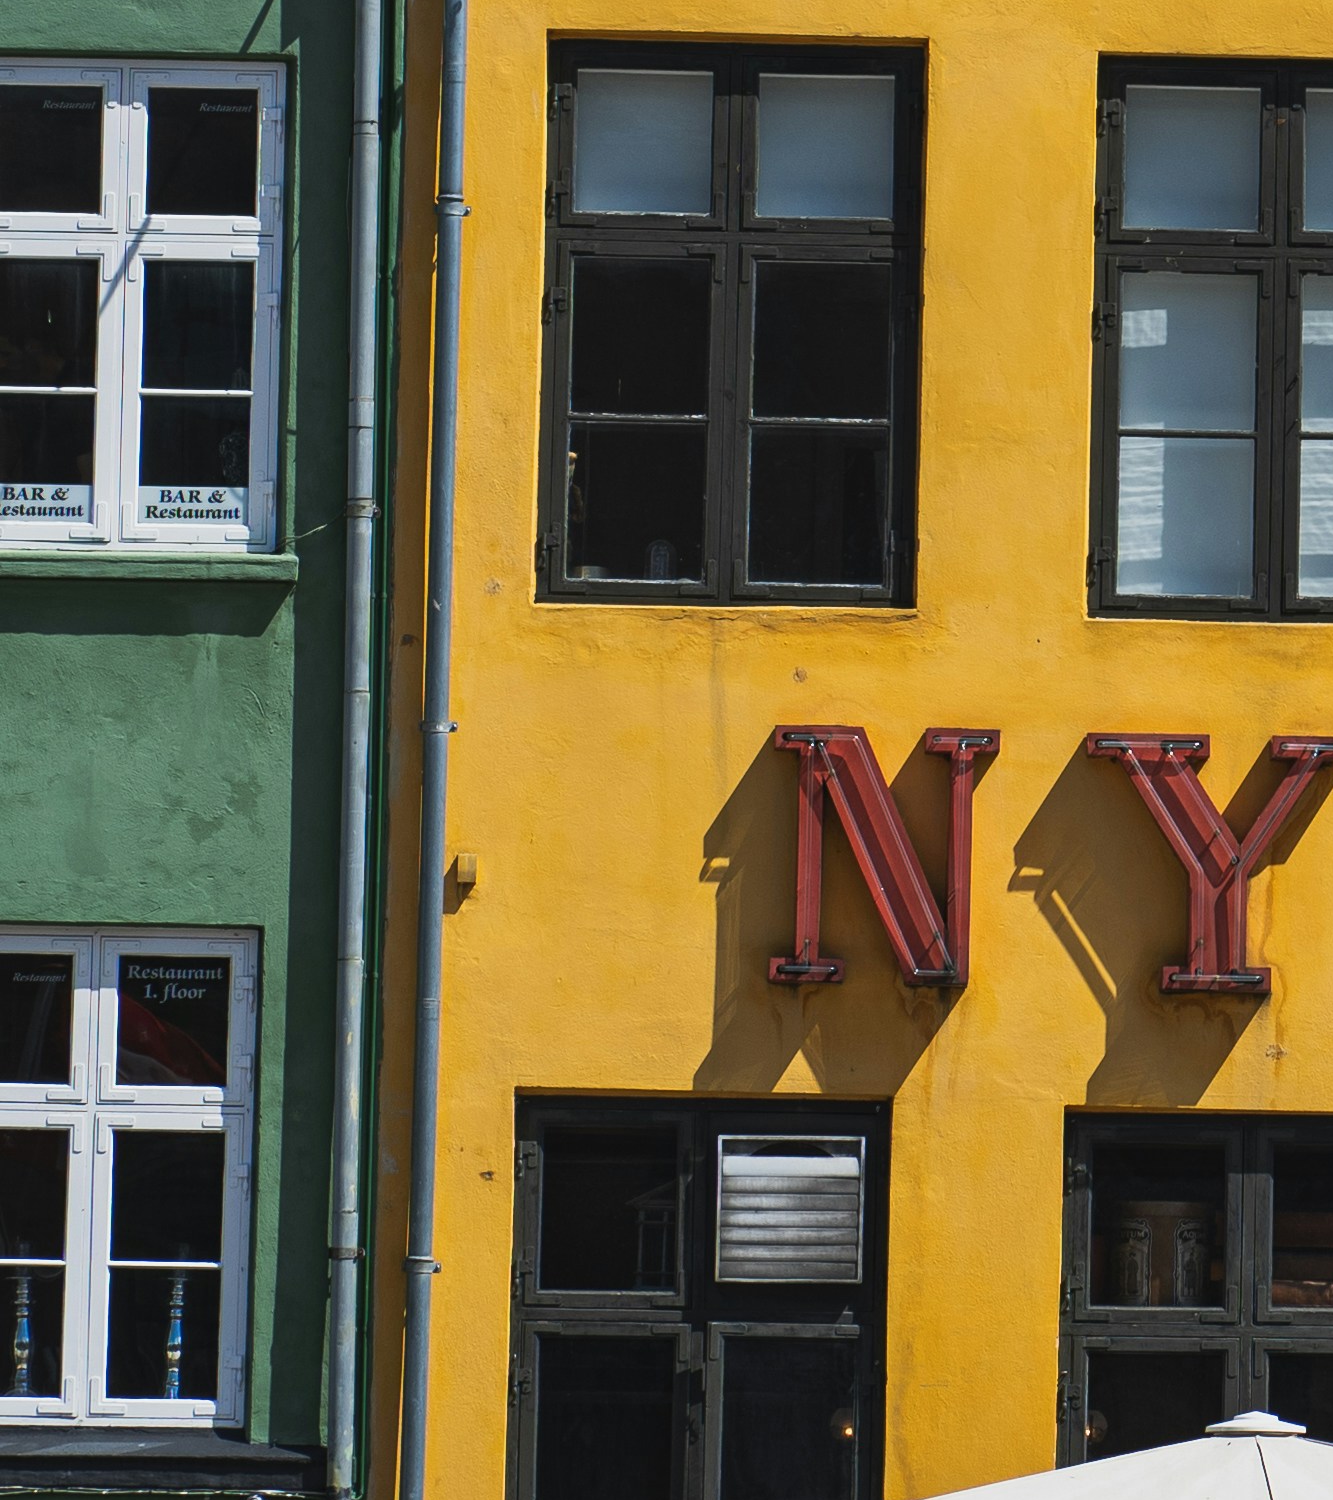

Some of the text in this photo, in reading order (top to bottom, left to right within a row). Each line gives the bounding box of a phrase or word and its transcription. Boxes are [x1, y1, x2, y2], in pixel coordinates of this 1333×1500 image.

[2, 486, 70, 501] BAR &
[158, 489, 227, 504] BAR &
[143, 504, 241, 520] Restaurant
[126, 964, 224, 981] Restaurant
[143, 982, 207, 1004] 1. floor
